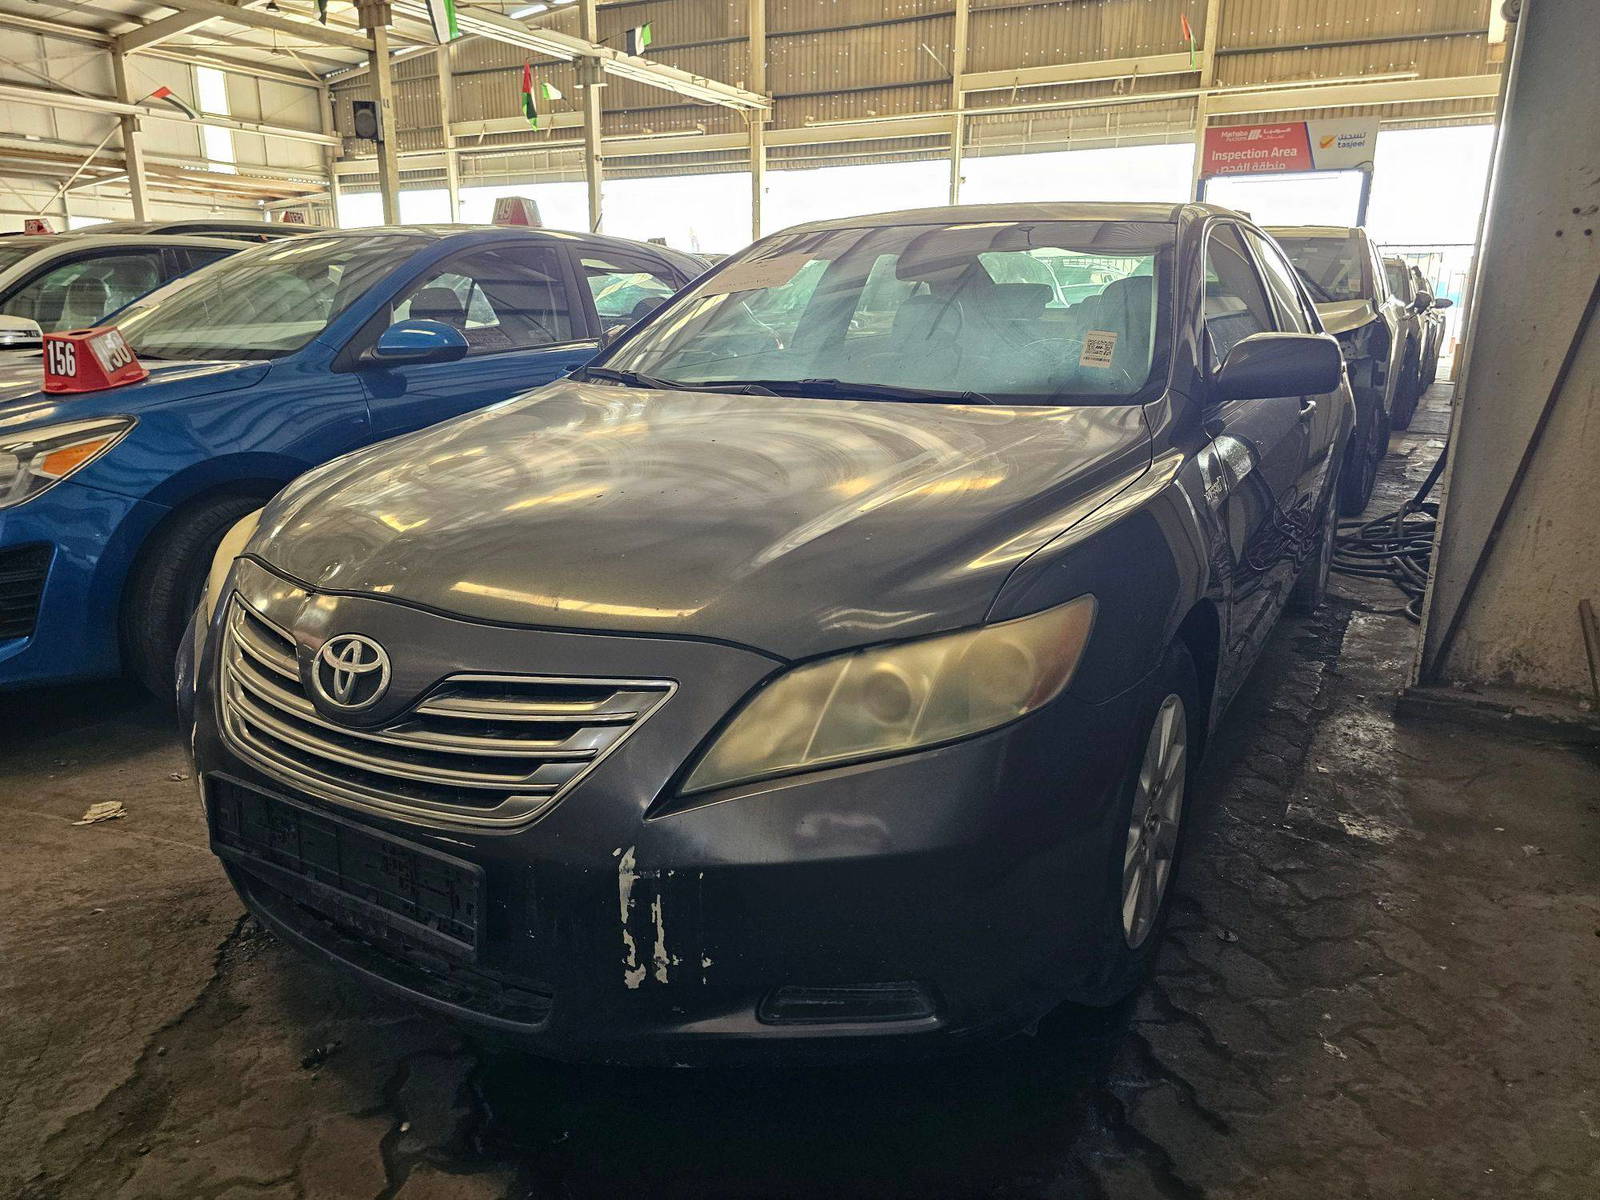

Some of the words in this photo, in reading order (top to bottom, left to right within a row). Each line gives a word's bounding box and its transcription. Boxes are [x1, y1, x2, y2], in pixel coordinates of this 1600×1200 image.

[1338, 139, 1365, 149] tasjeel
[1212, 148, 1268, 162] Inspection
[1271, 146, 1297, 157] Area
[47, 340, 76, 377] 156
